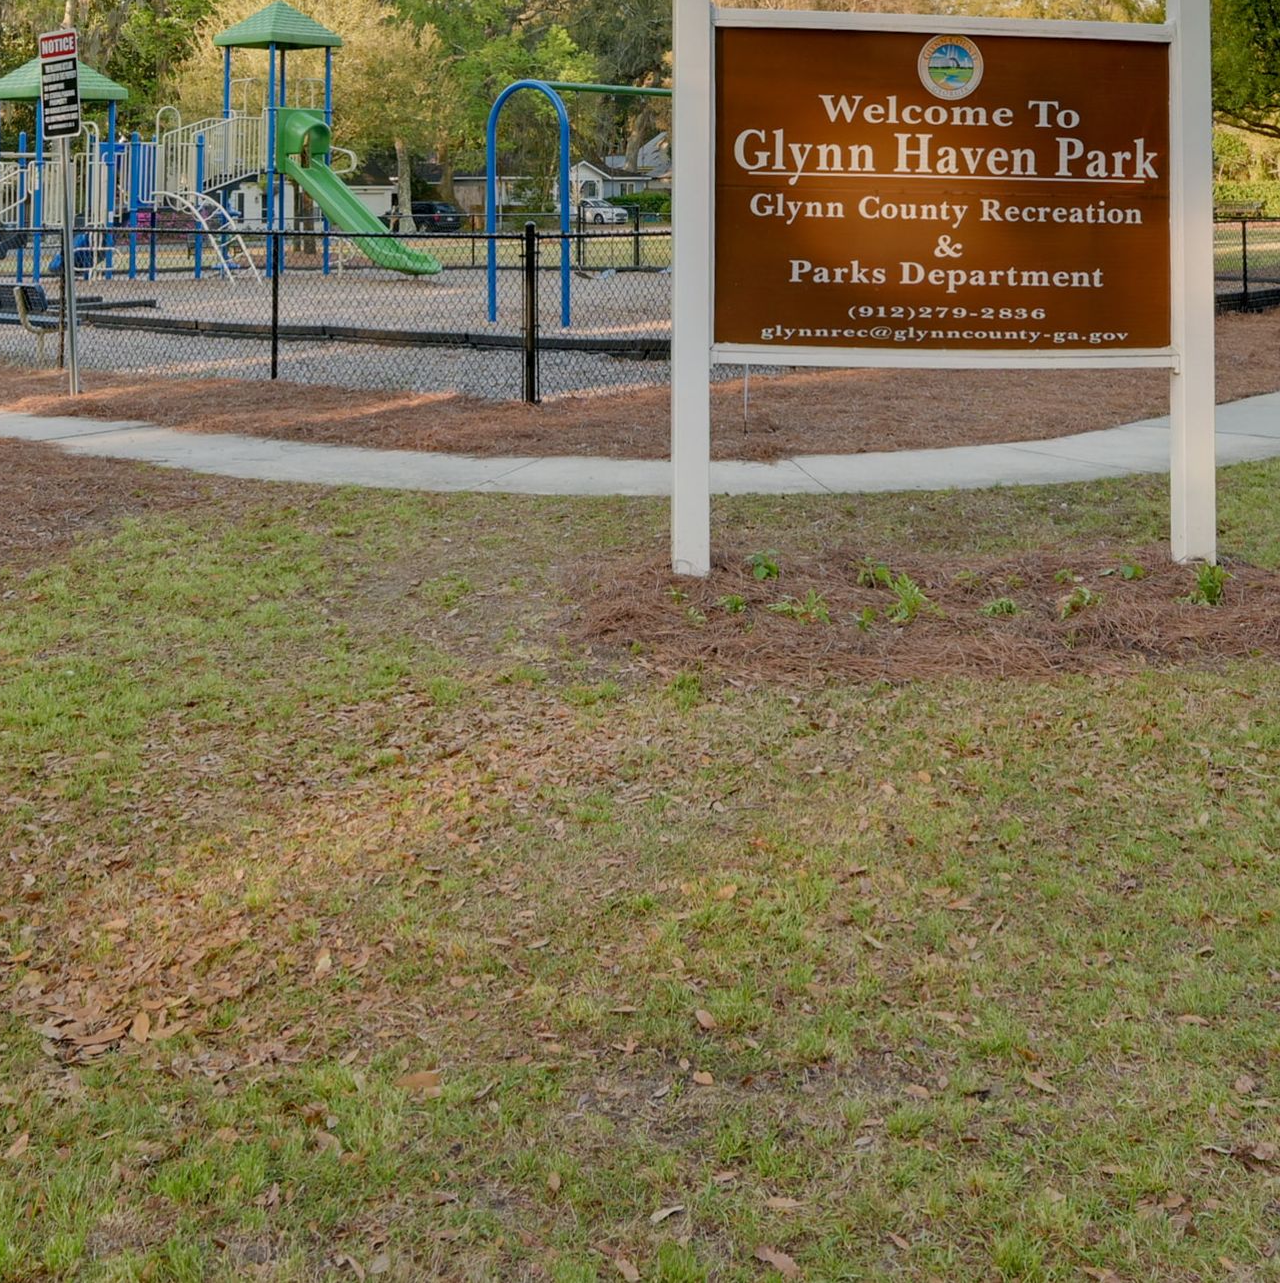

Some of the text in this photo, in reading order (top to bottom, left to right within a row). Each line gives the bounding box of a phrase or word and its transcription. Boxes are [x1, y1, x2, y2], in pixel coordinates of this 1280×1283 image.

[41, 36, 75, 55] NOTICE
[818, 94, 1081, 129] Welcome To
[733, 128, 1159, 186] Glynn Haven Park
[749, 192, 1143, 229] Glynn County Recreation
[933, 234, 964, 258] &
[788, 259, 1104, 294] Parks Department
[847, 305, 1047, 320] (912)279-2836
[760, 324, 1129, 344] glynnrec@glynncounty-ga.gov
